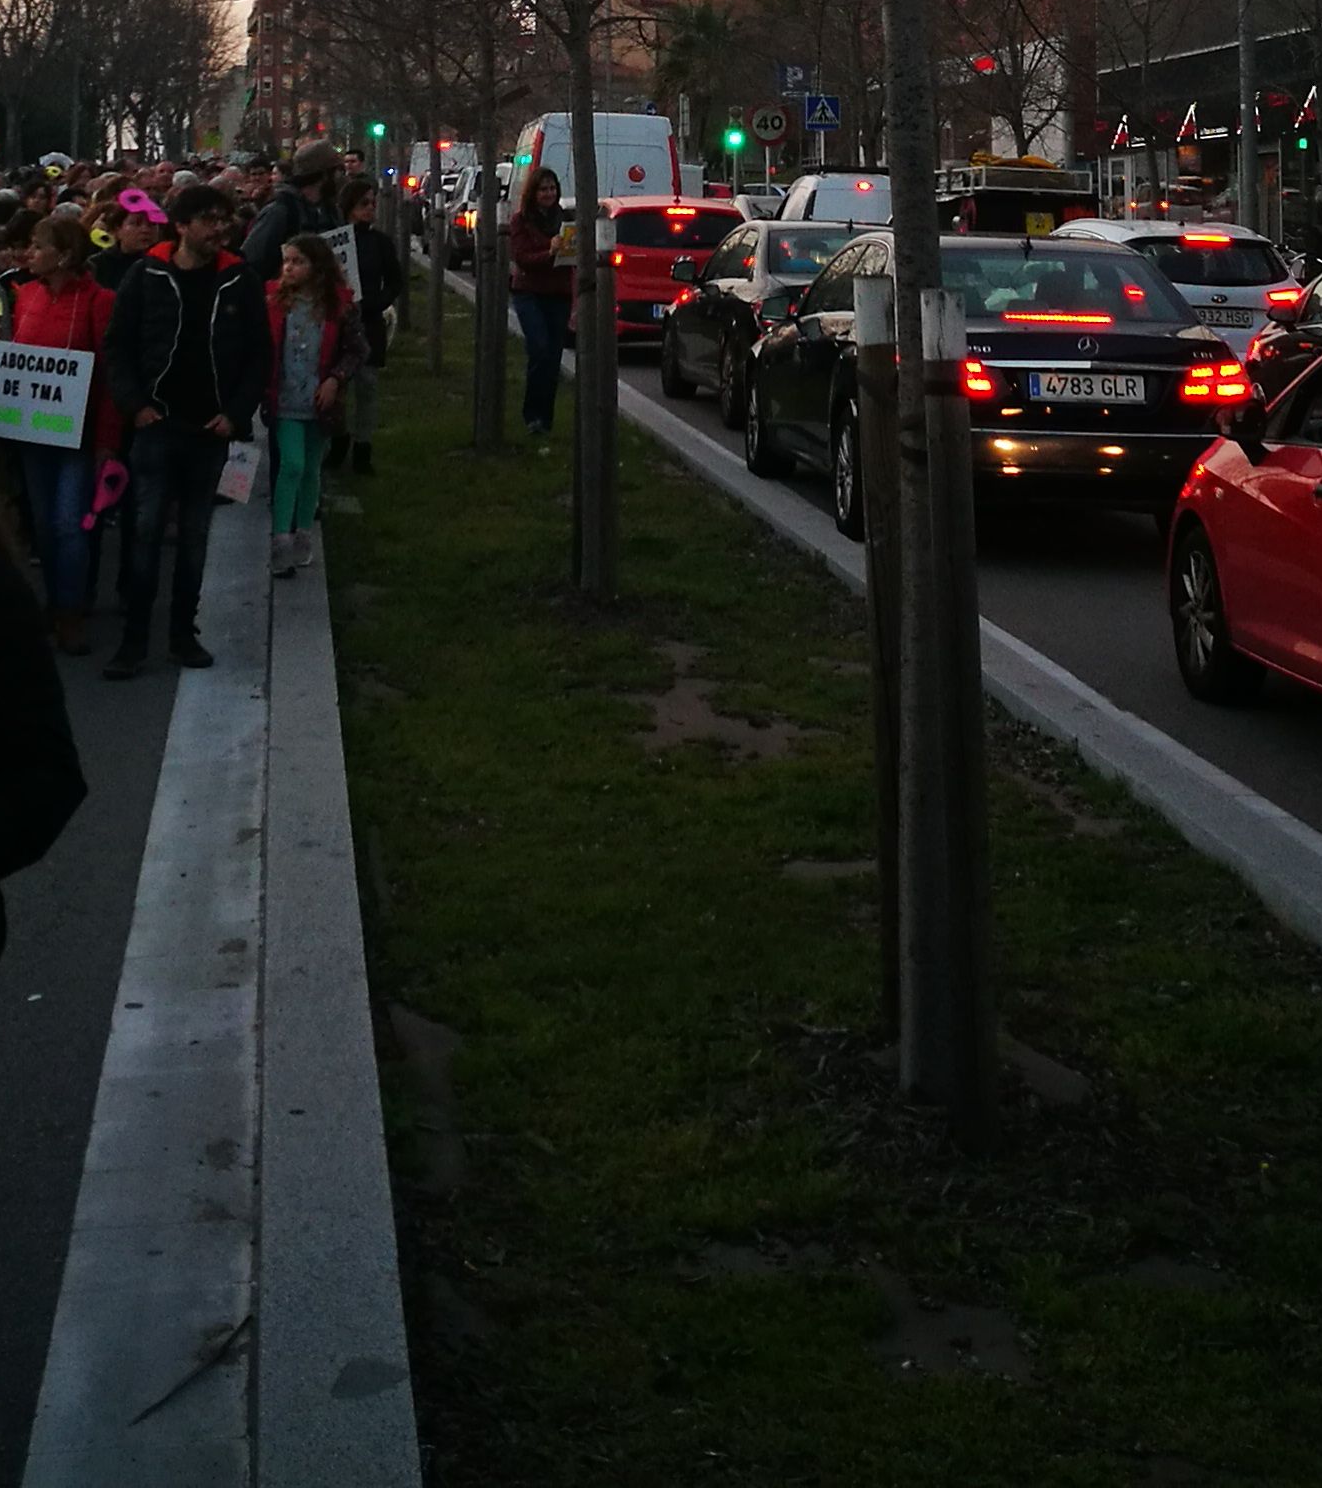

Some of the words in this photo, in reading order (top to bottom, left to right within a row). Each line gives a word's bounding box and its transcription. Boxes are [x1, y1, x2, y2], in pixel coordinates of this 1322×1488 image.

[756, 115, 783, 131] 40
[1199, 310, 1222, 322] 932
[0, 352, 78, 377] ABOCADOR
[3, 380, 20, 396] DE
[1046, 378, 1094, 395] 4783
[1101, 380, 1137, 396] GLR
